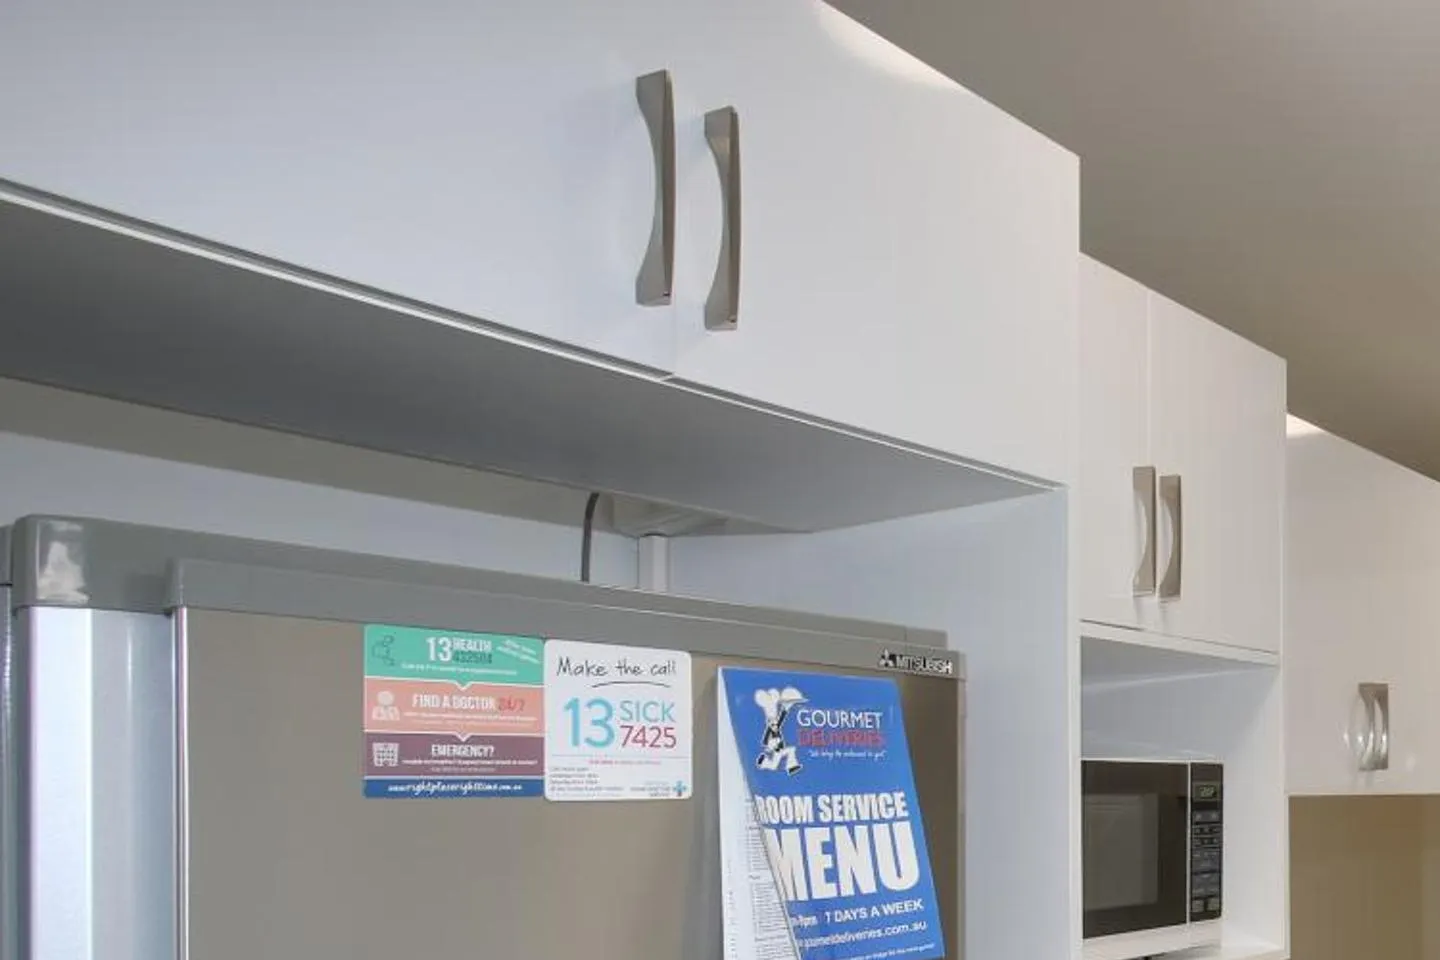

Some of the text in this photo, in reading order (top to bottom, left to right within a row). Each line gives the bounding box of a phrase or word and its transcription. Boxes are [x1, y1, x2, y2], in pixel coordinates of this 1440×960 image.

[426, 636, 450, 661] 13
[557, 656, 677, 677] Make the call
[412, 694, 440, 707] FIND
[564, 697, 676, 748] 13 SICK
[797, 709, 884, 730] GOURMET
[620, 725, 677, 748] 7425
[798, 729, 885, 748] DELIVERIES
[817, 791, 909, 822] SERVICE
[762, 820, 920, 901] MENU
[834, 907, 868, 924] DAYS
[870, 905, 881, 919] A
[881, 898, 925, 917] WEEK
